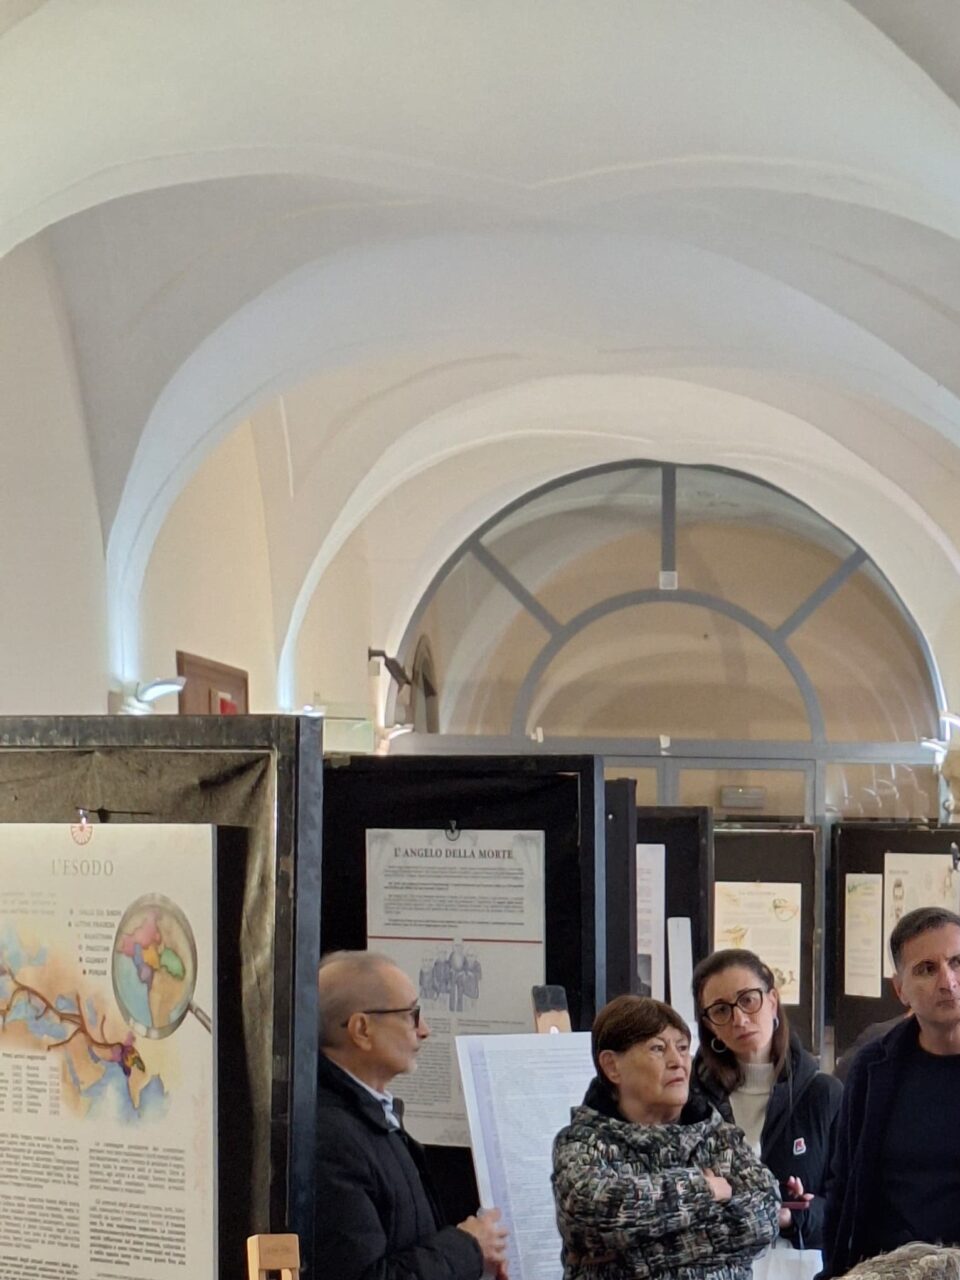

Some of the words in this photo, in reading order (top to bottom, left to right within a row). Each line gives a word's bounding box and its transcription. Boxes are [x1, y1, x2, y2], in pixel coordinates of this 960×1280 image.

[404, 848, 443, 858] ANGELO
[446, 849, 476, 859] DELLA
[479, 850, 513, 859] MORTE
